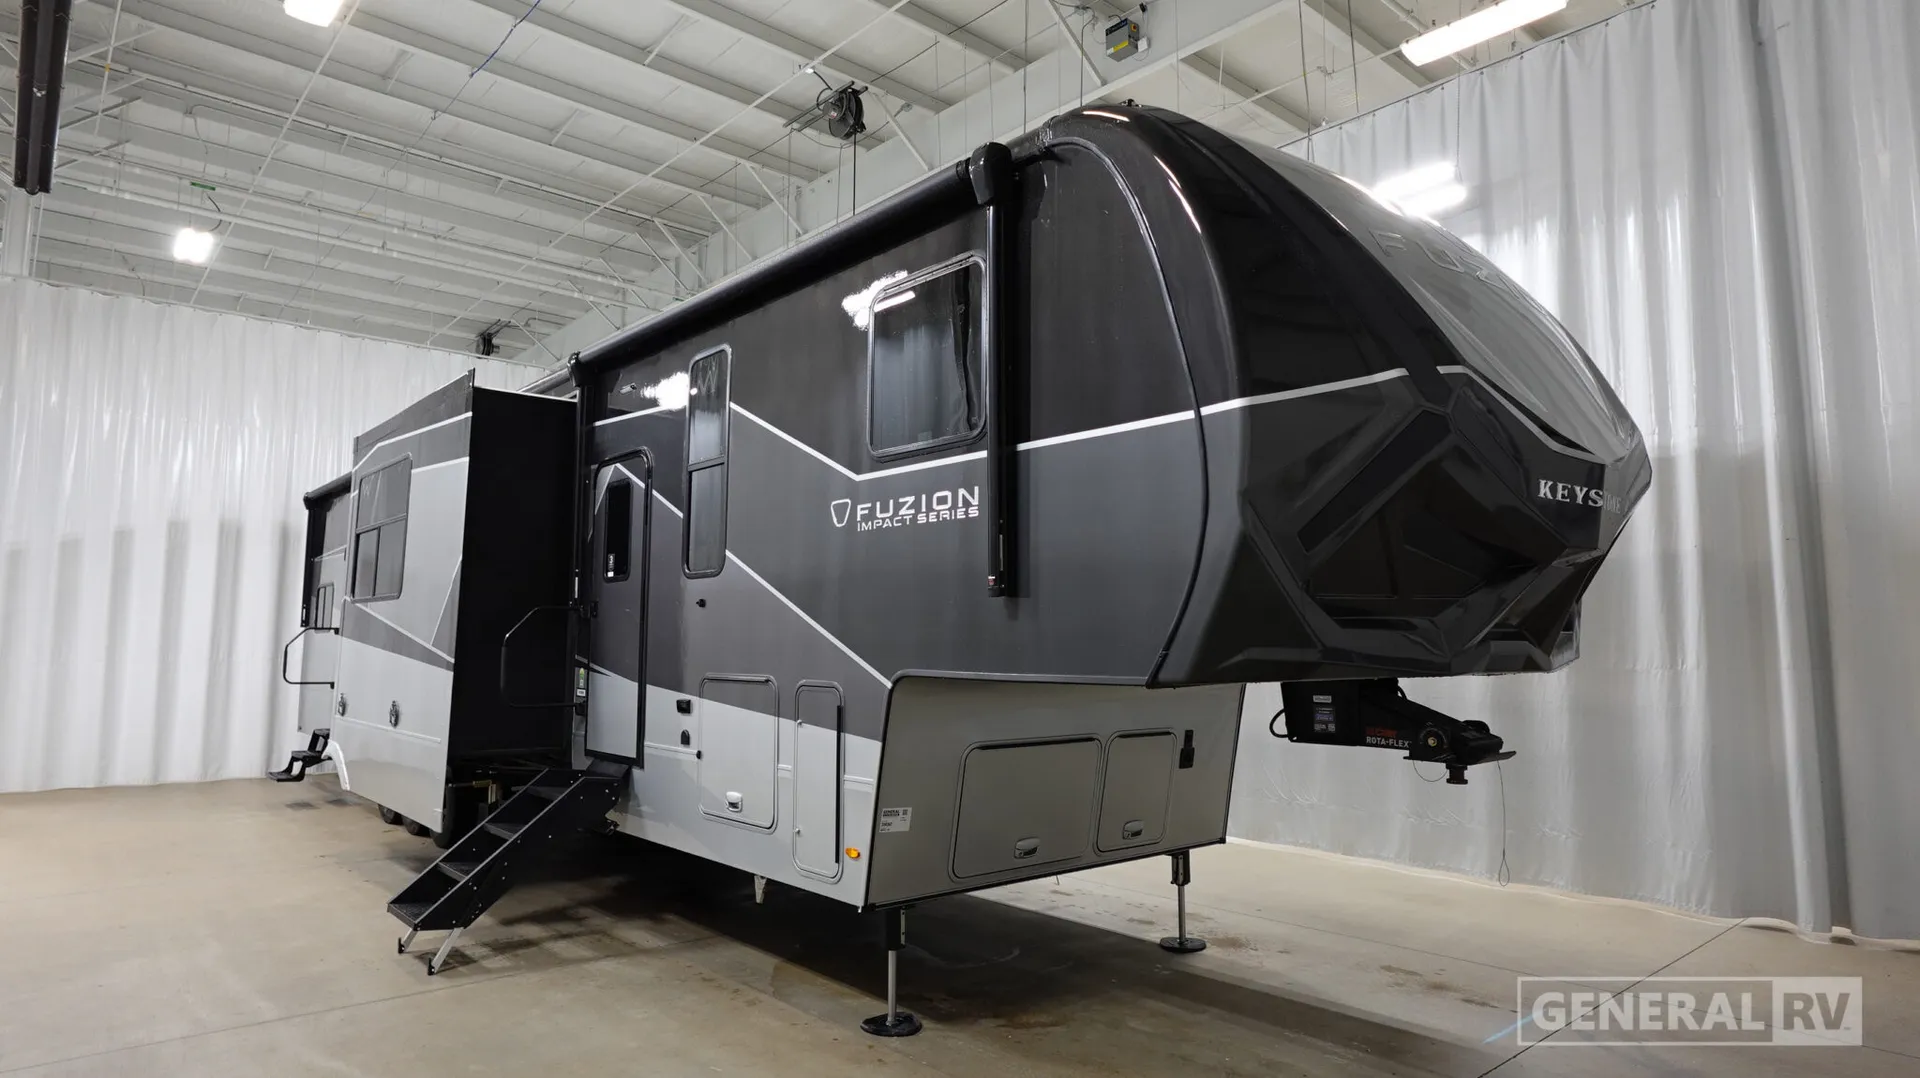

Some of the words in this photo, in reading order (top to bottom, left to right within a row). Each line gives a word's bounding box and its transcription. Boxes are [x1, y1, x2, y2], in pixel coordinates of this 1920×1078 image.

[857, 486, 979, 521] FUZION
[857, 515, 912, 530] IMPACT
[917, 507, 979, 523] SERIES
